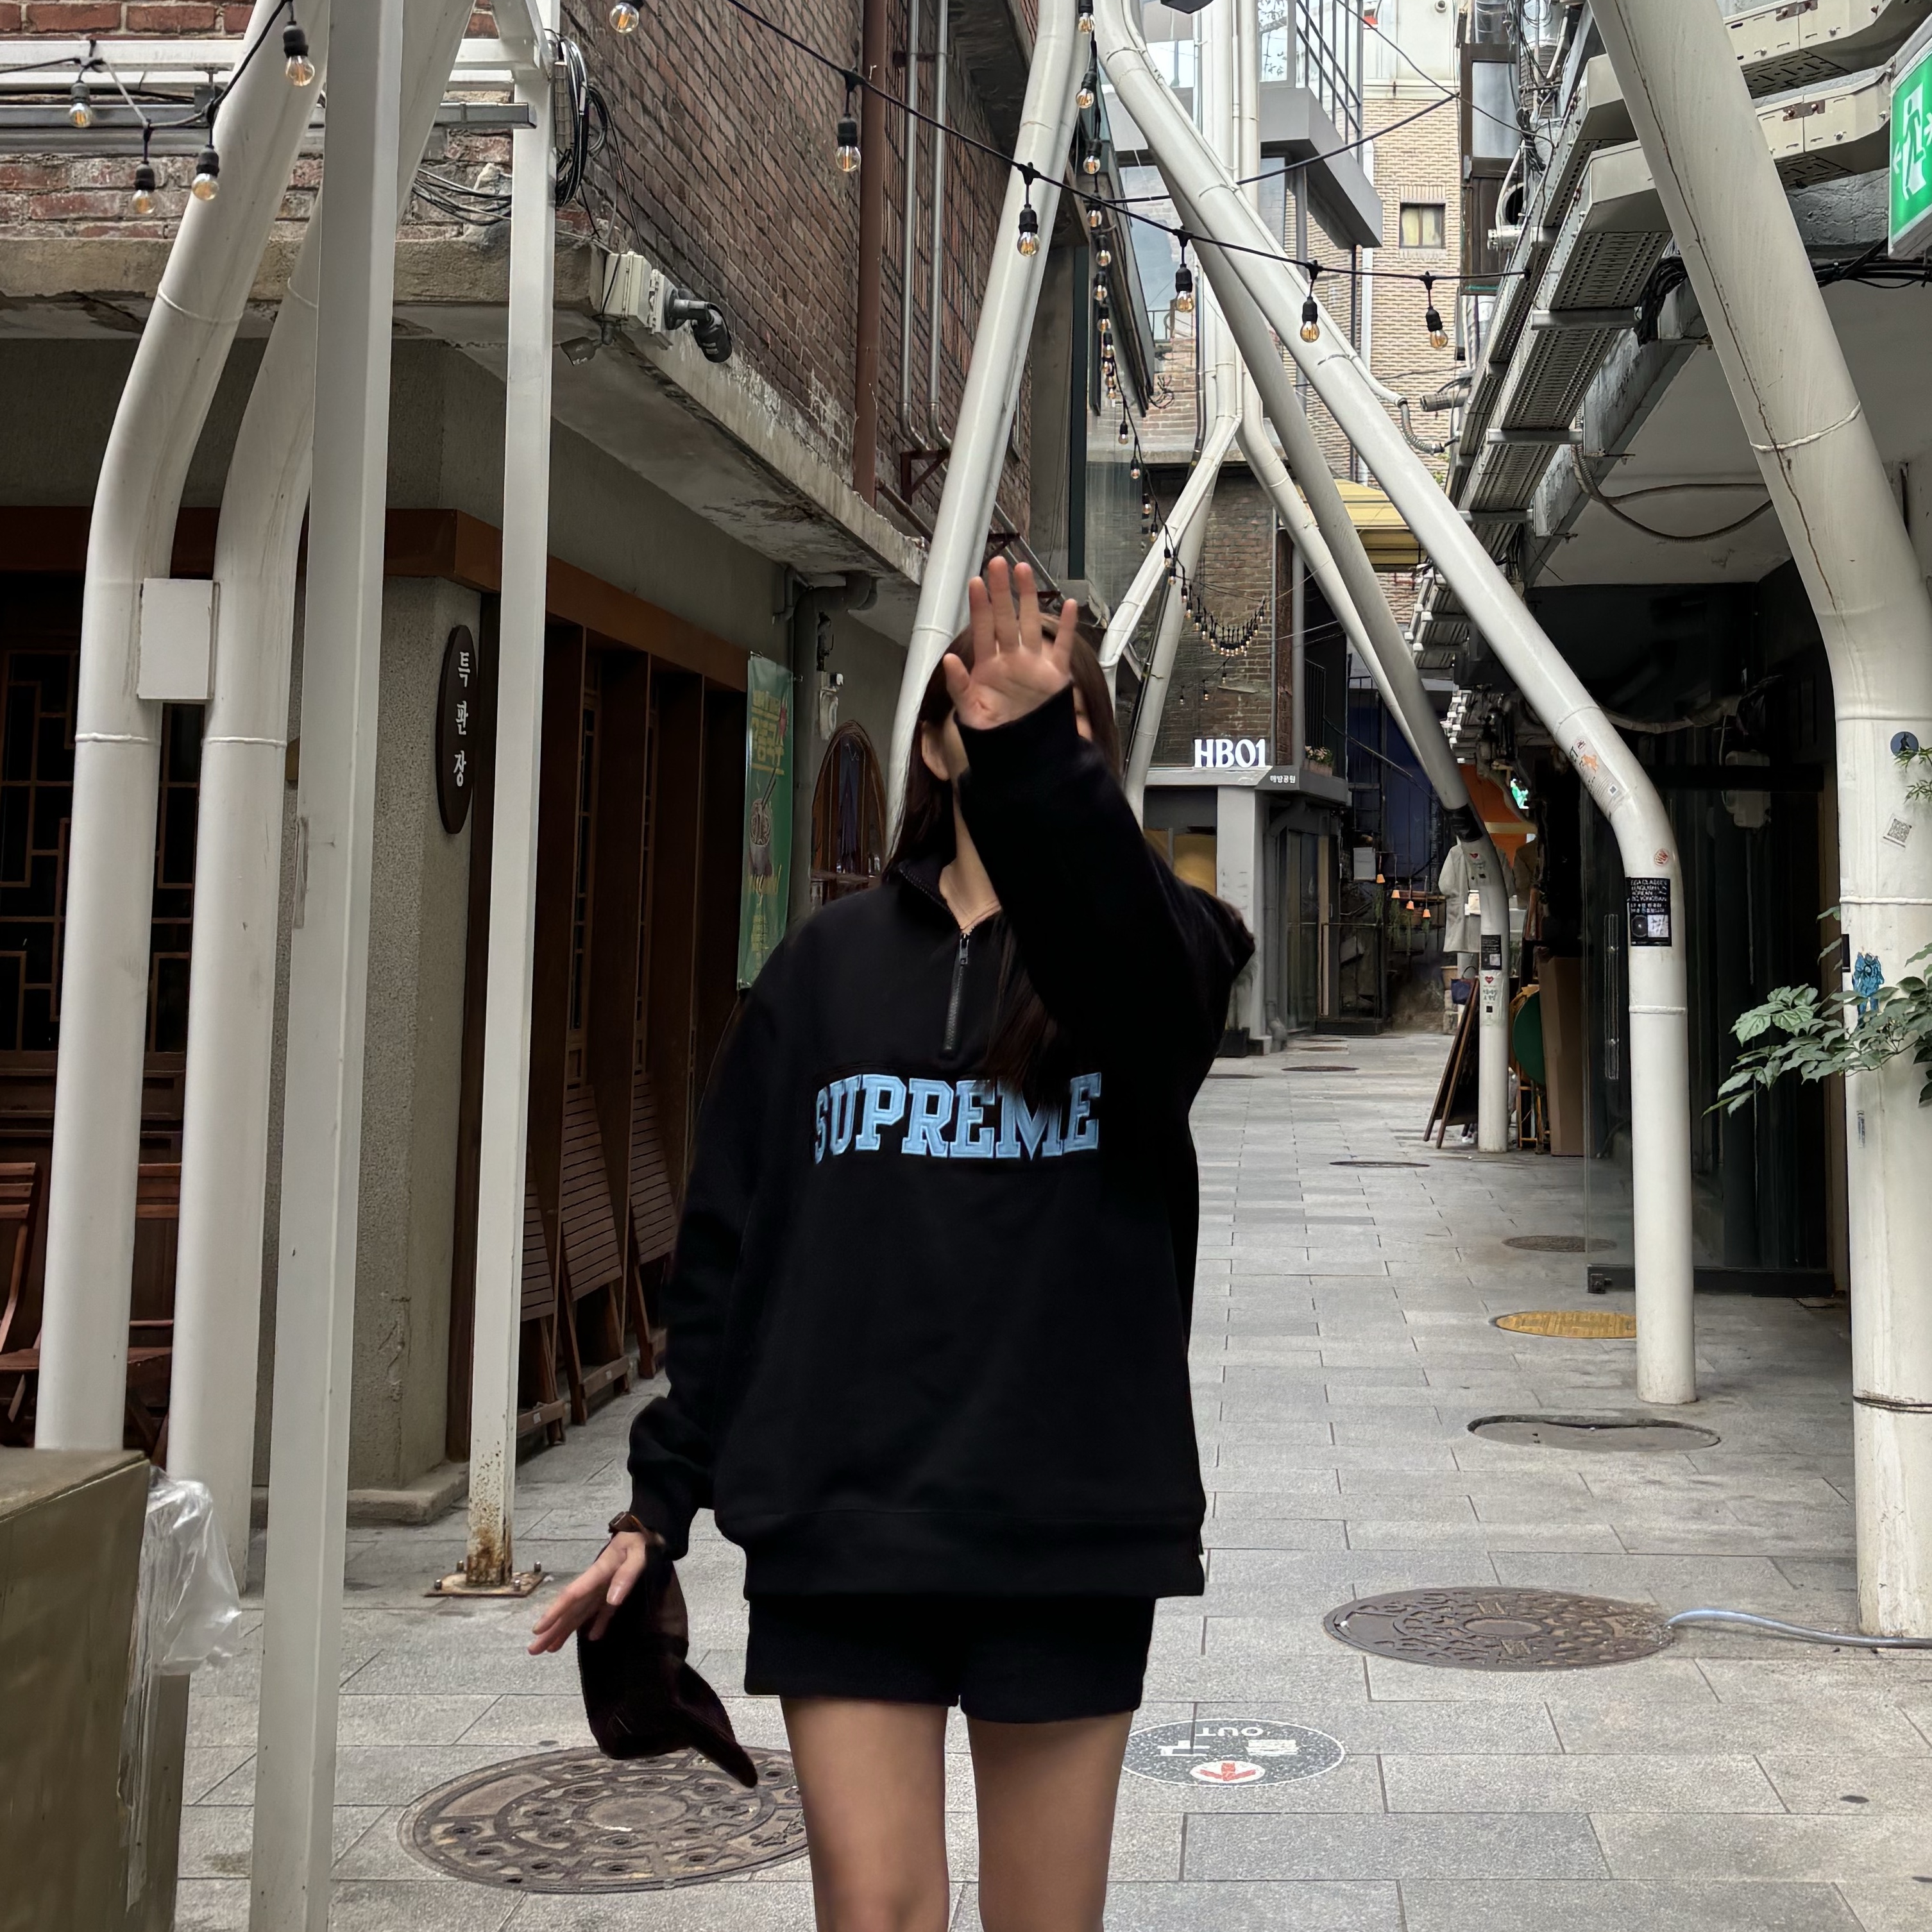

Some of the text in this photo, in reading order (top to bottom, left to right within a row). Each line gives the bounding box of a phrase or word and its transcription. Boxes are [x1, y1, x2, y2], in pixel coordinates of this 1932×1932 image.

[453, 651, 471, 787] 특판장
[815, 1072, 1102, 1165] SUPREME
[1195, 1726, 1264, 1738] OUT
